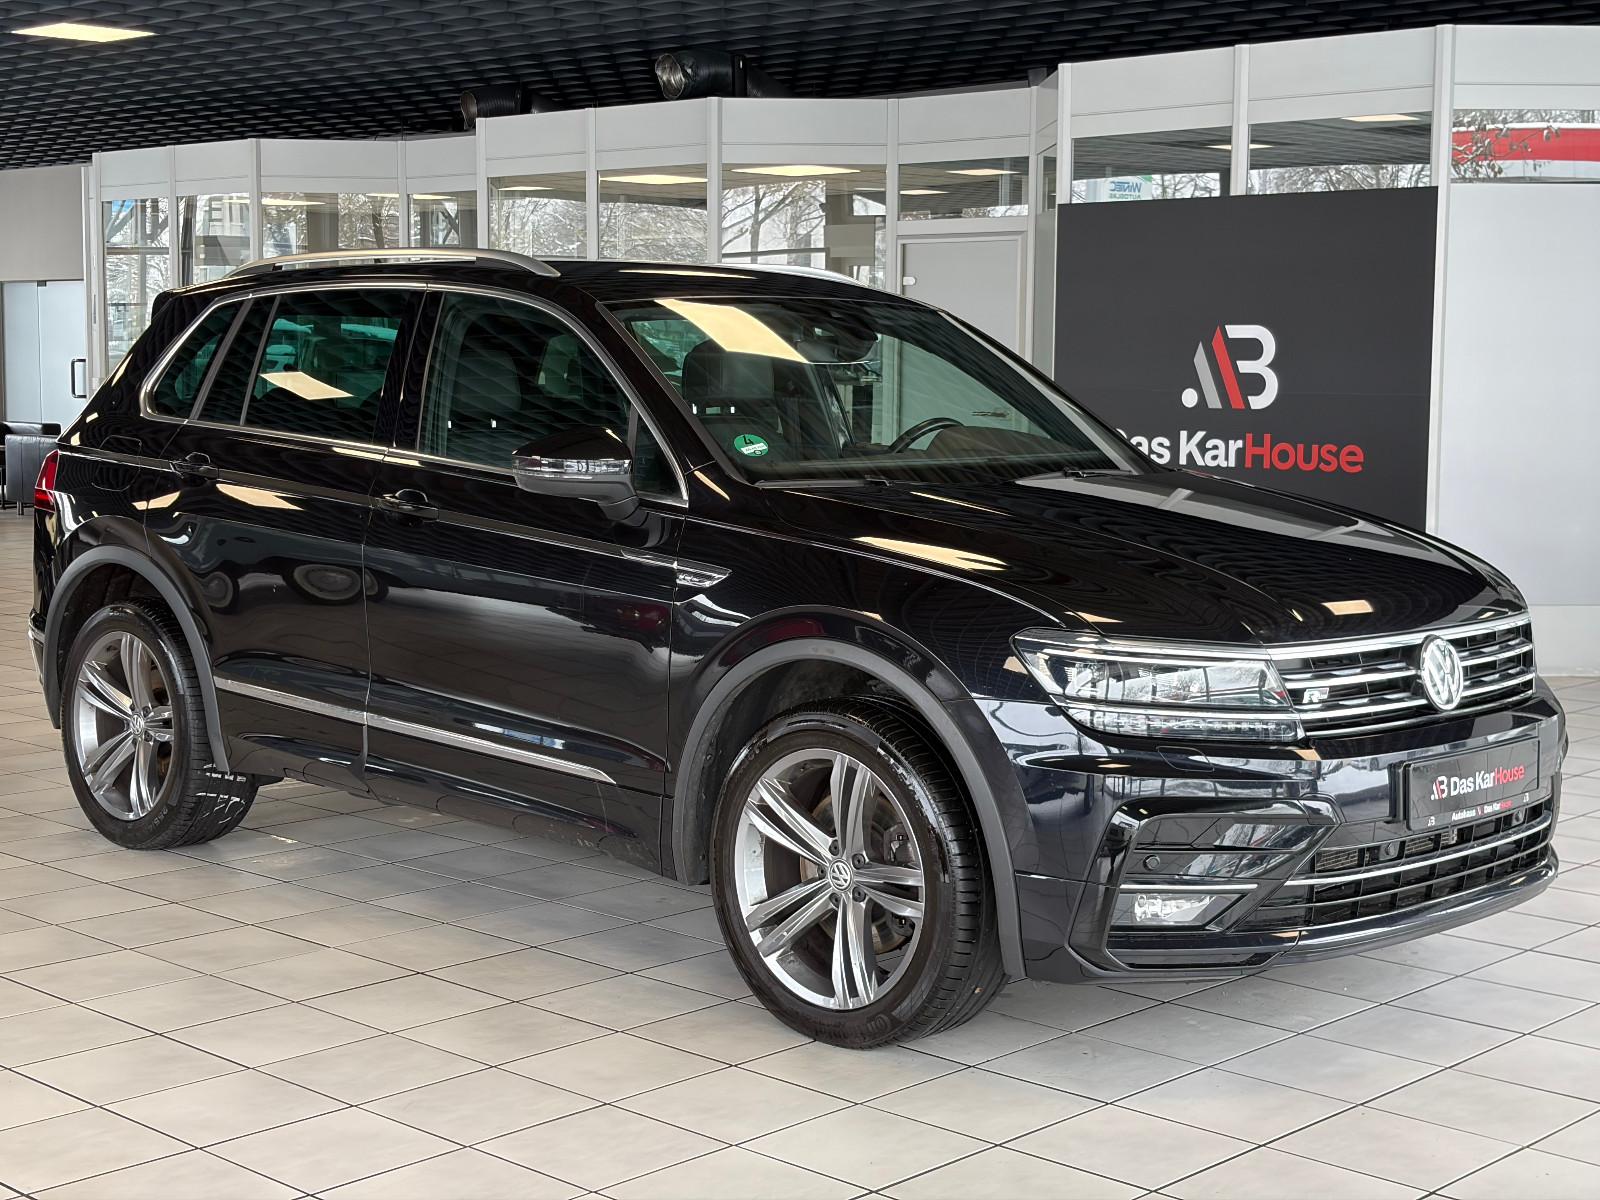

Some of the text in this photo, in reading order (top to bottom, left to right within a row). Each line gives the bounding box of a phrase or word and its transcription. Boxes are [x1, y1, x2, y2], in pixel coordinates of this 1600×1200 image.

[1116, 428, 1364, 474] as KarHouse
[1450, 777, 1474, 796] Das
[1475, 766, 1525, 791] KarHouse
